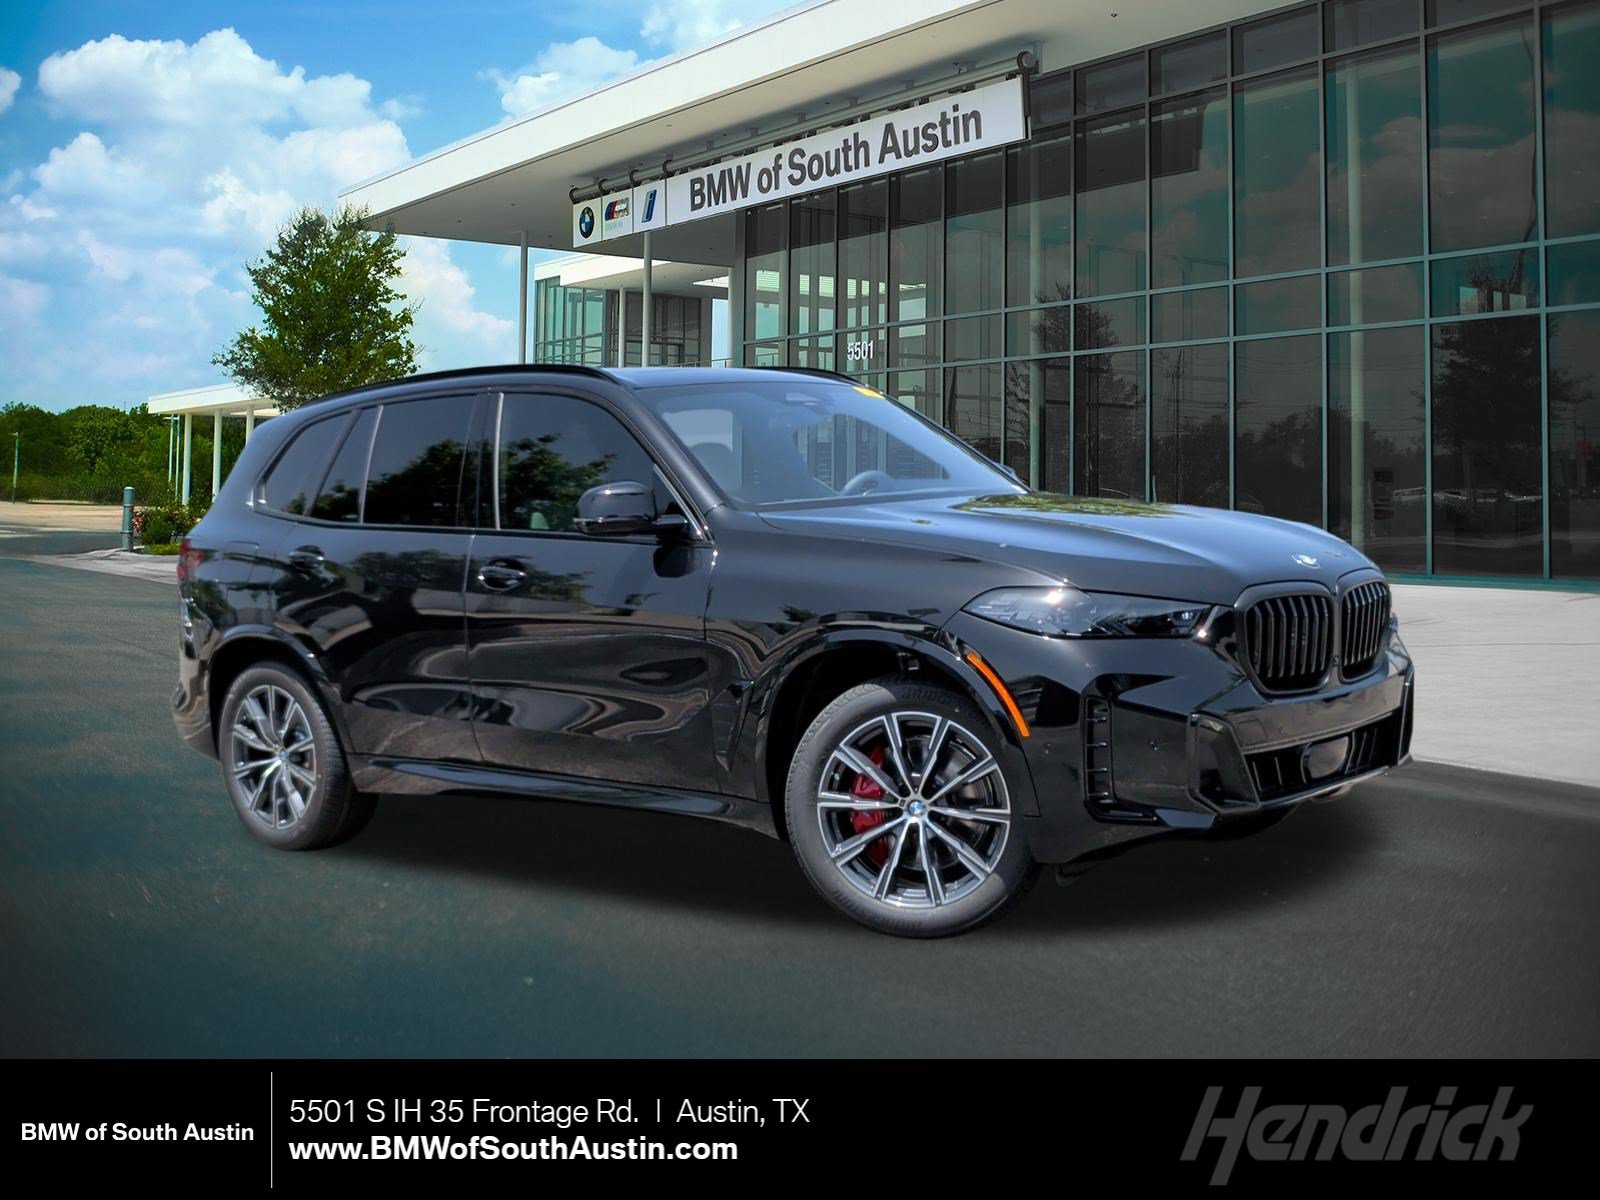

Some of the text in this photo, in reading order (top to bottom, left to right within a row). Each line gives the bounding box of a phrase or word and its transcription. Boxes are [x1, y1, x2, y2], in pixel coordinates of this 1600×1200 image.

[690, 104, 982, 212] BMW of South Austin
[847, 340, 873, 360] 5501
